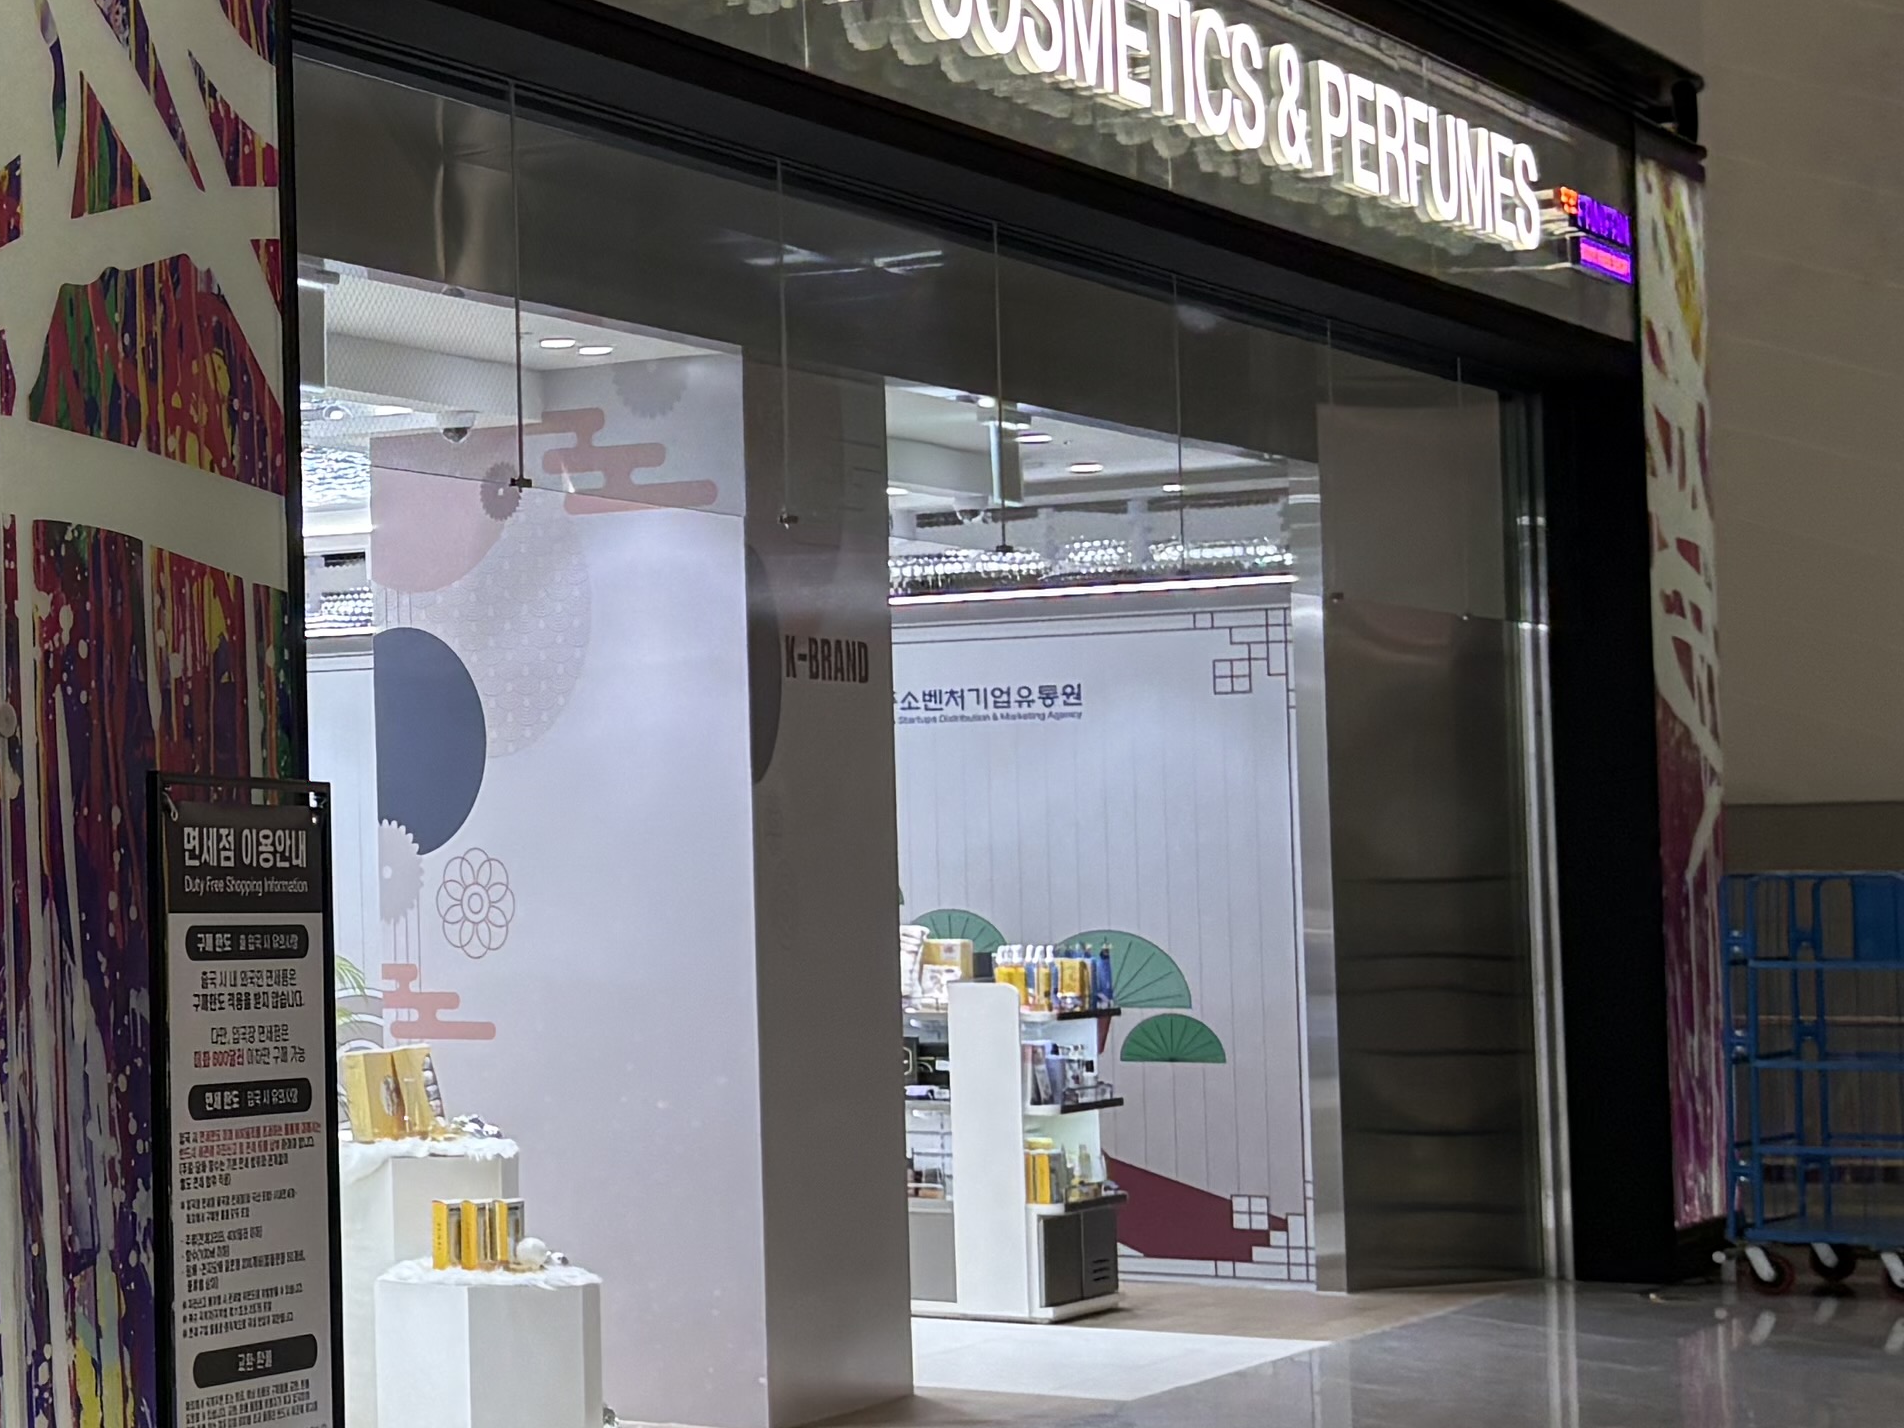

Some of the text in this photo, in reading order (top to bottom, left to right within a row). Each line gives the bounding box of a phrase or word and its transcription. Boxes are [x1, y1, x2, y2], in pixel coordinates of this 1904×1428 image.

[1268, 44, 1311, 169] &
[1314, 64, 1541, 251] PERFUMES
[784, 634, 870, 684] K-BRAND
[893, 683, 1083, 712] 소벤처기업유통원
[183, 826, 307, 868] 면세점 이용안내
[184, 876, 308, 896] Duty Free Shopping Information
